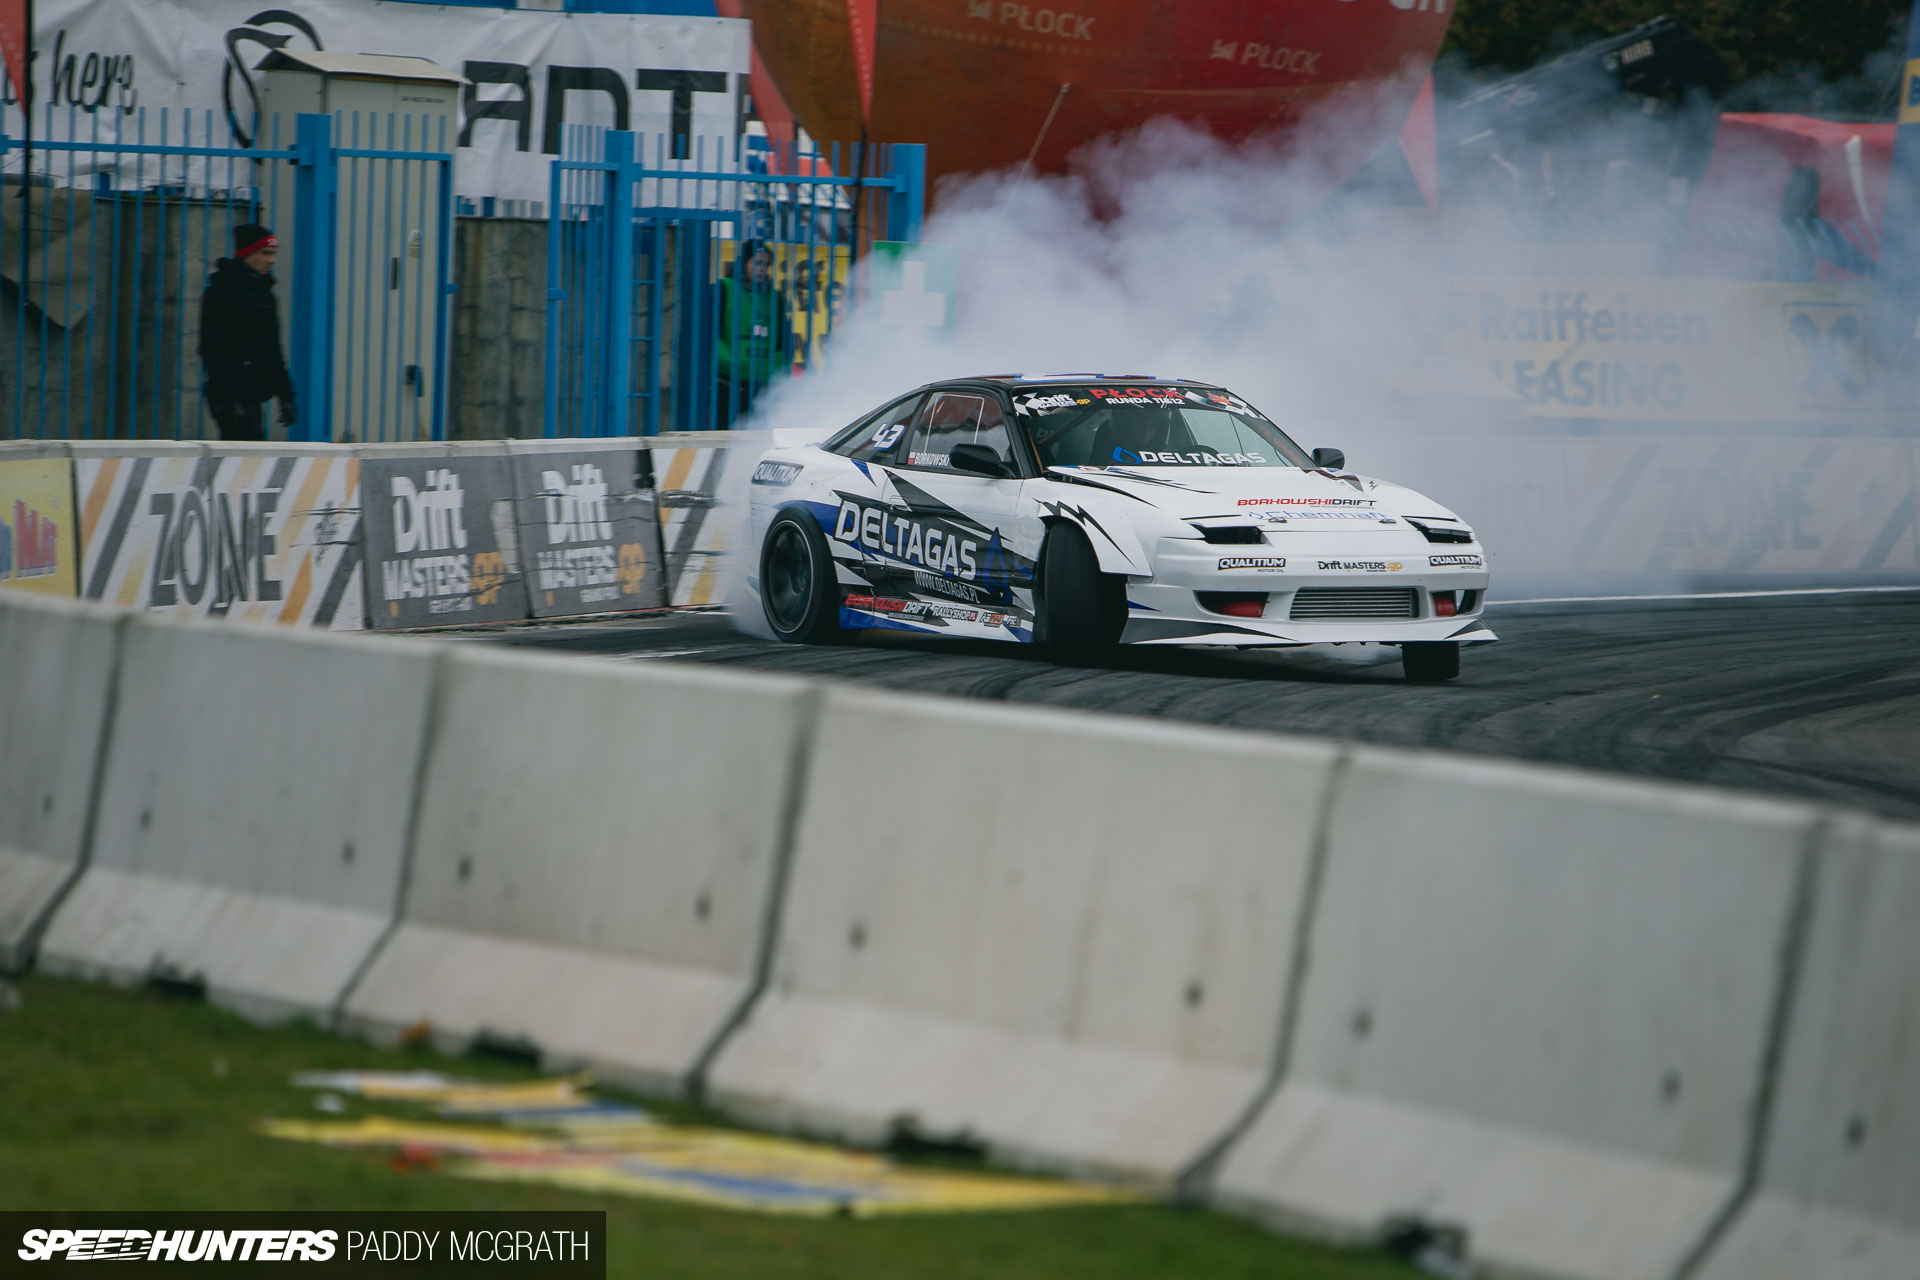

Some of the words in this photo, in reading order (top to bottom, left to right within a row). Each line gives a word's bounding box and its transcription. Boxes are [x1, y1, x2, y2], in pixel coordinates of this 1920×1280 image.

[457, 60, 750, 162] ANT
[1479, 290, 1709, 345] Raiffeisen
[872, 423, 906, 451] 43
[1138, 450, 1267, 465] DELTAGAS
[390, 468, 468, 553] Drift
[541, 463, 614, 545] Drift
[150, 486, 282, 608] ZONE
[834, 499, 978, 581] DELTAGAS
[1430, 555, 1482, 566] QUALITIUM
[1220, 558, 1285, 568] QUALITIUM
[1318, 560, 1343, 570] Drift
[914, 570, 981, 604] WWW.DELTAGAS.PL
